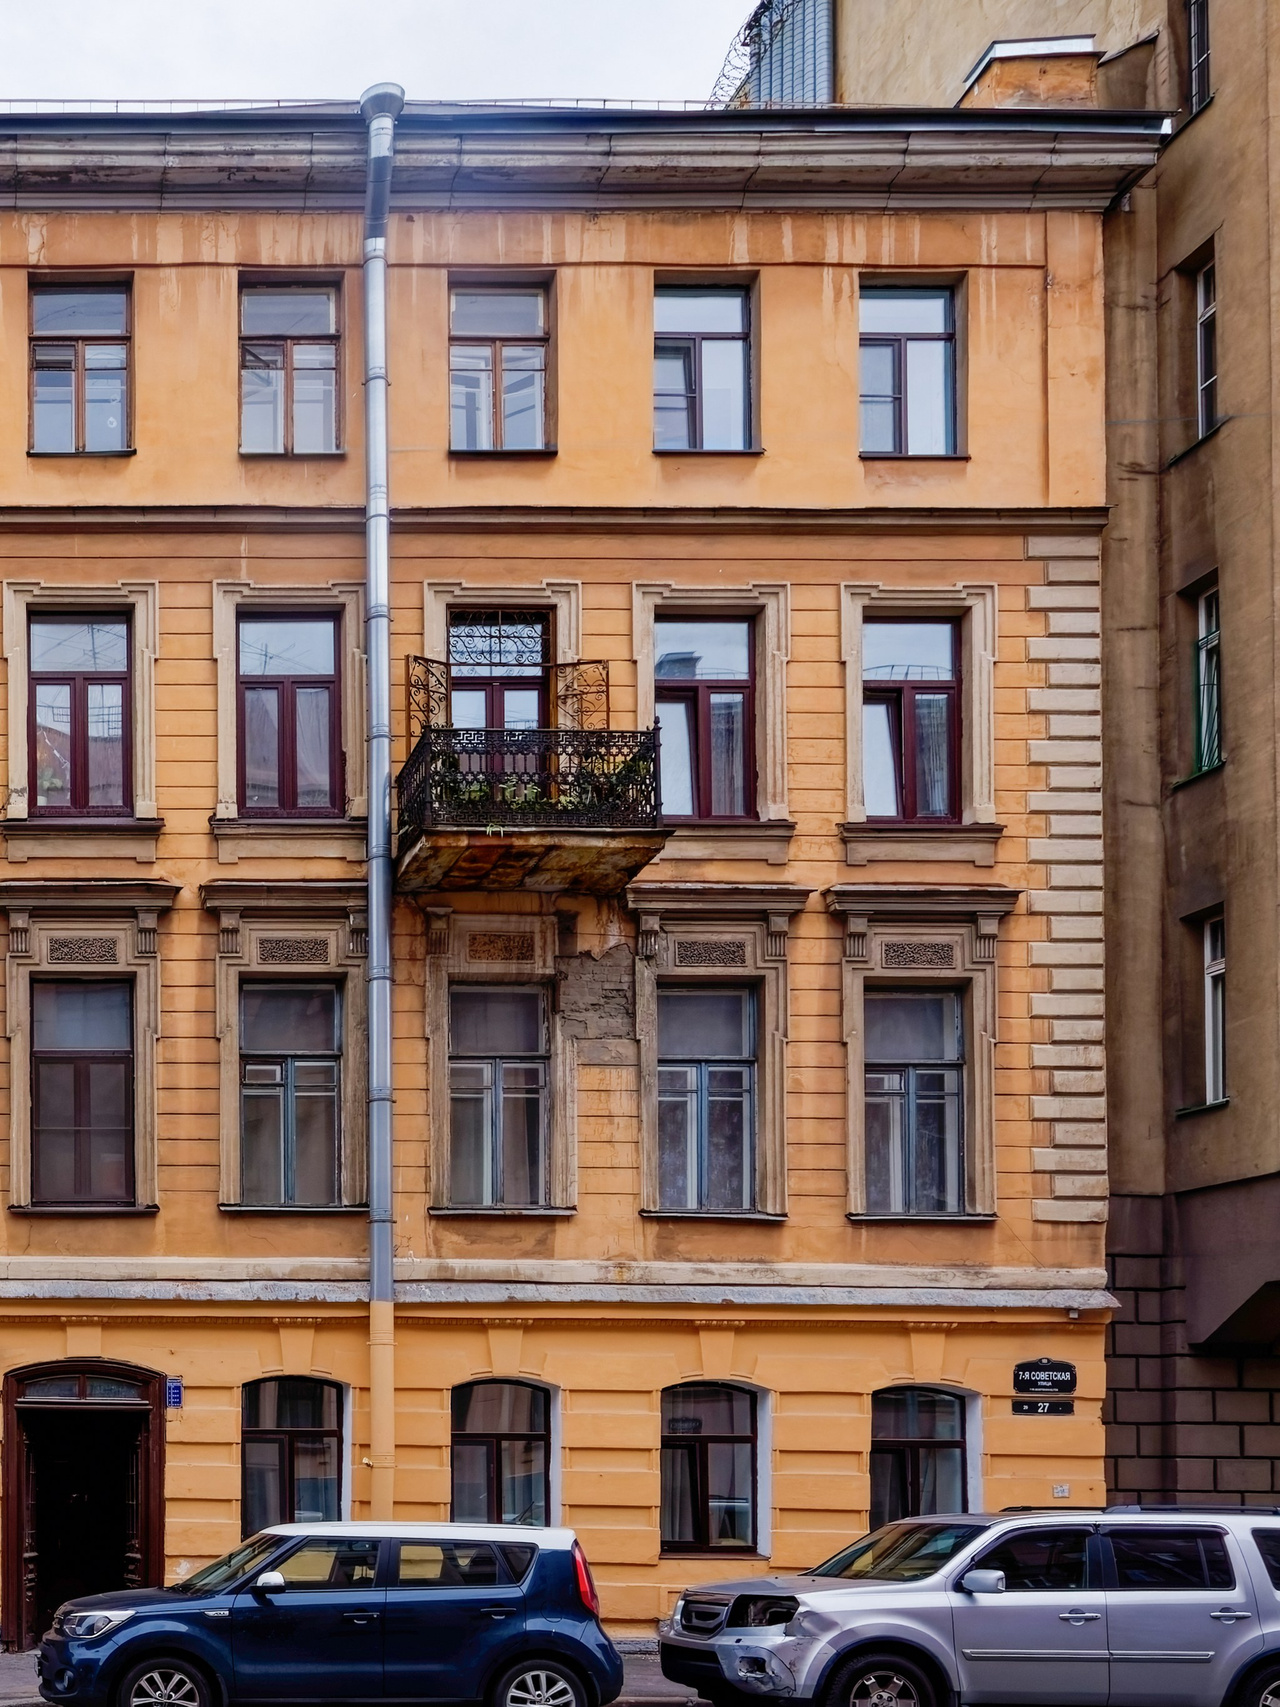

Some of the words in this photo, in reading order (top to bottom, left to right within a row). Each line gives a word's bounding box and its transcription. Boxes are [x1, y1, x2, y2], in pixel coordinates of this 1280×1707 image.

[1018, 1371, 1030, 1380] 7-Я
[1030, 1371, 1071, 1380] СОВЕТСКАЯ
[1037, 1402, 1050, 1413] 27
